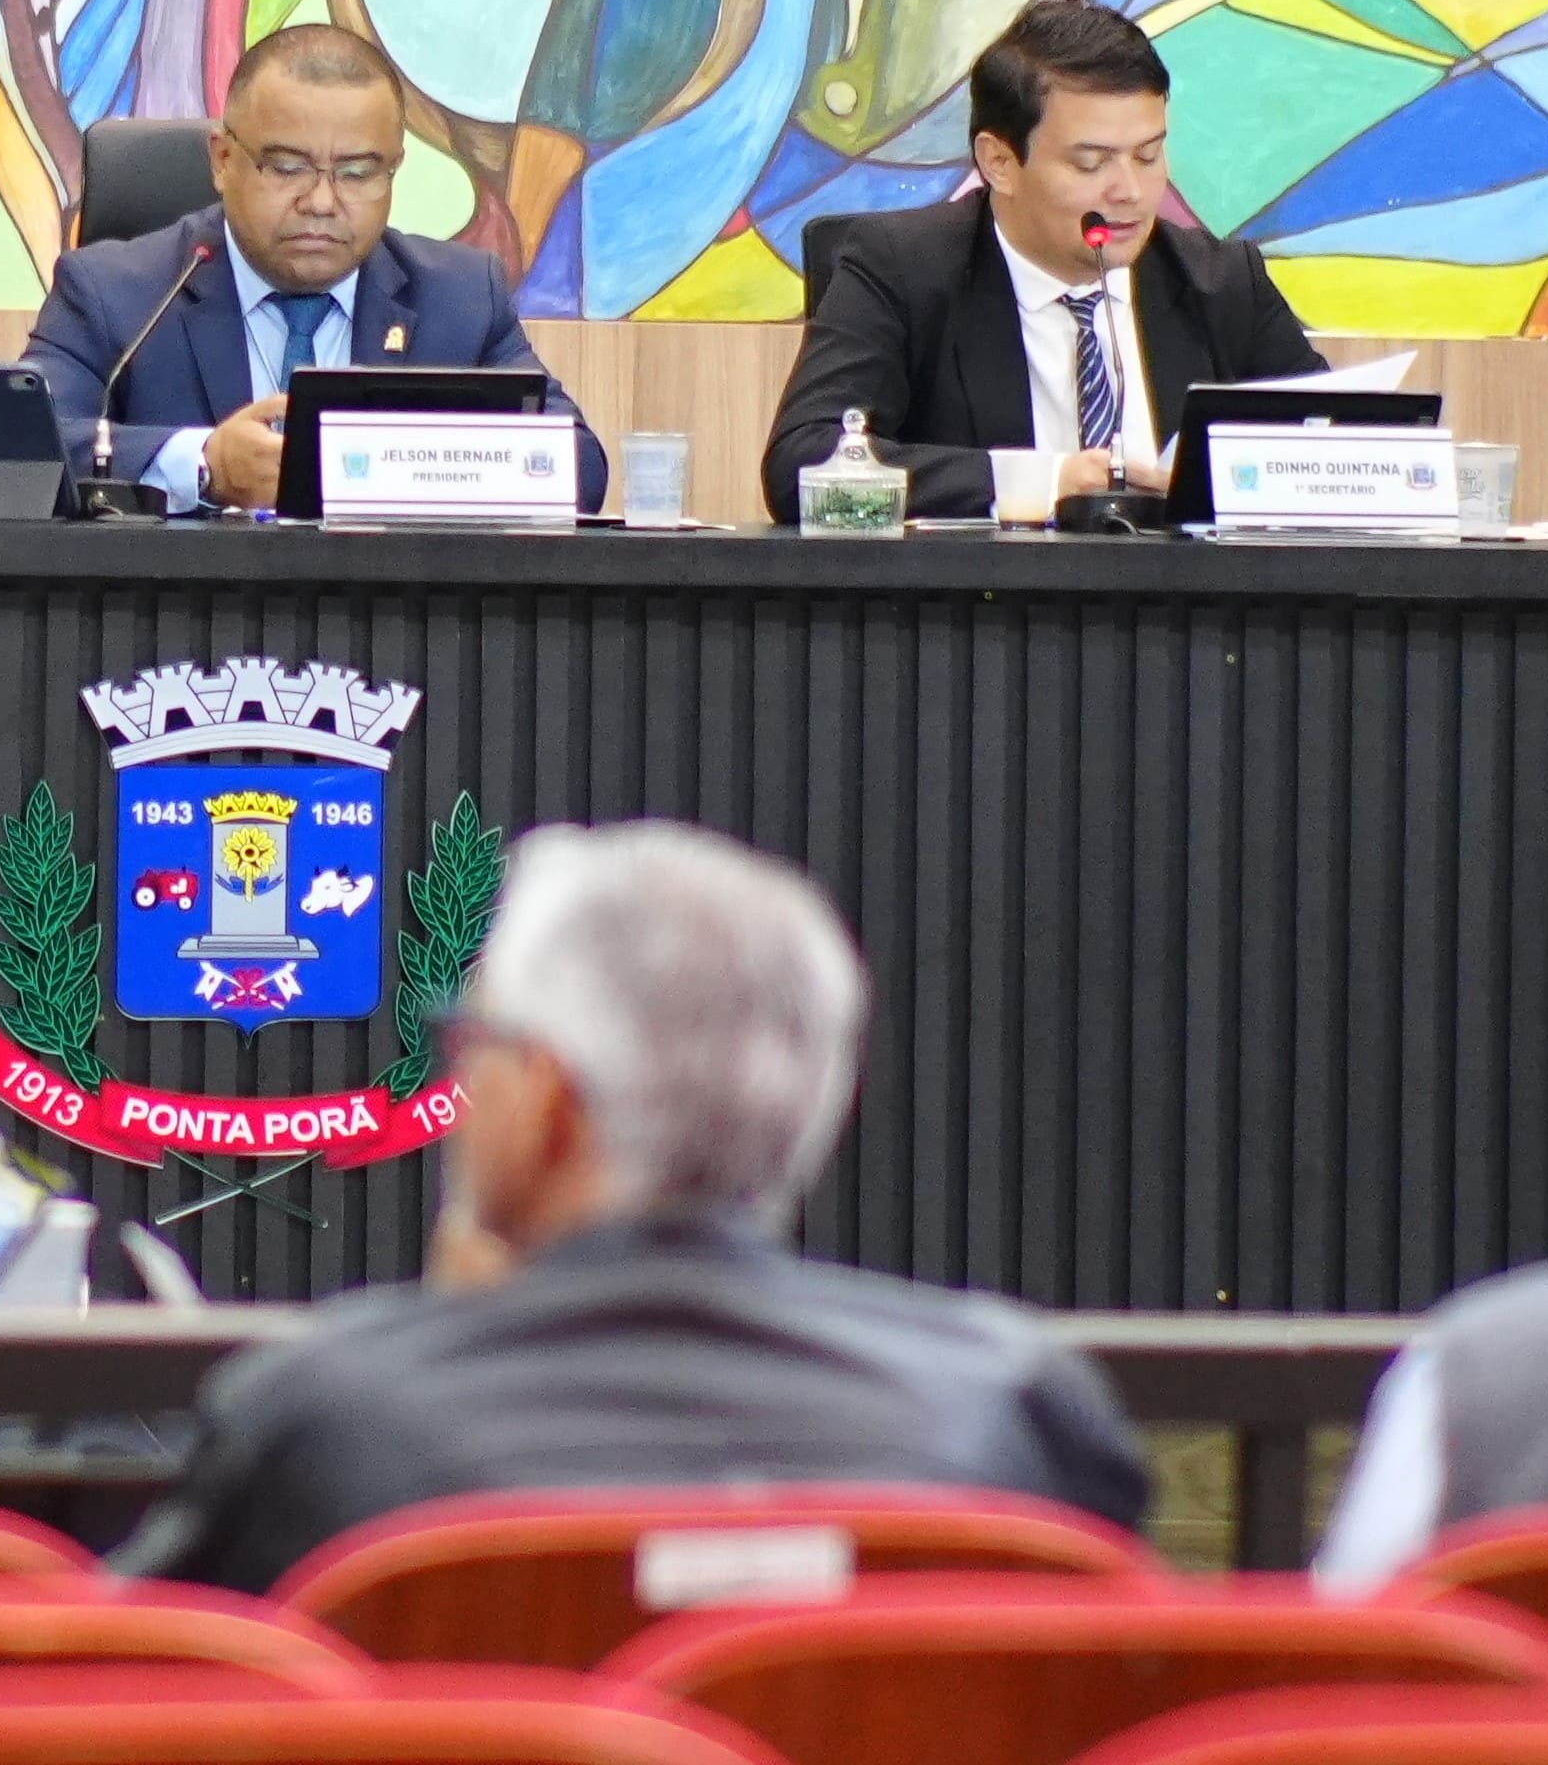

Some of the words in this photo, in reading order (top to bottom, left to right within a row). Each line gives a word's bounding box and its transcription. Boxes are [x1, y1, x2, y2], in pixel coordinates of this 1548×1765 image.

[380, 449, 438, 463] JELSON
[443, 448, 512, 464] BERNABÉ
[412, 472, 483, 484] PRESIDENTE
[1266, 461, 1321, 475] EDINHO
[1326, 462, 1401, 476] QUINTANA
[132, 801, 193, 825] 1943
[312, 802, 373, 826] 1946
[3, 1060, 85, 1127] 1913
[411, 1082, 473, 1134] 191
[120, 1097, 255, 1145] PONTA
[264, 1097, 379, 1143] PORÃ
